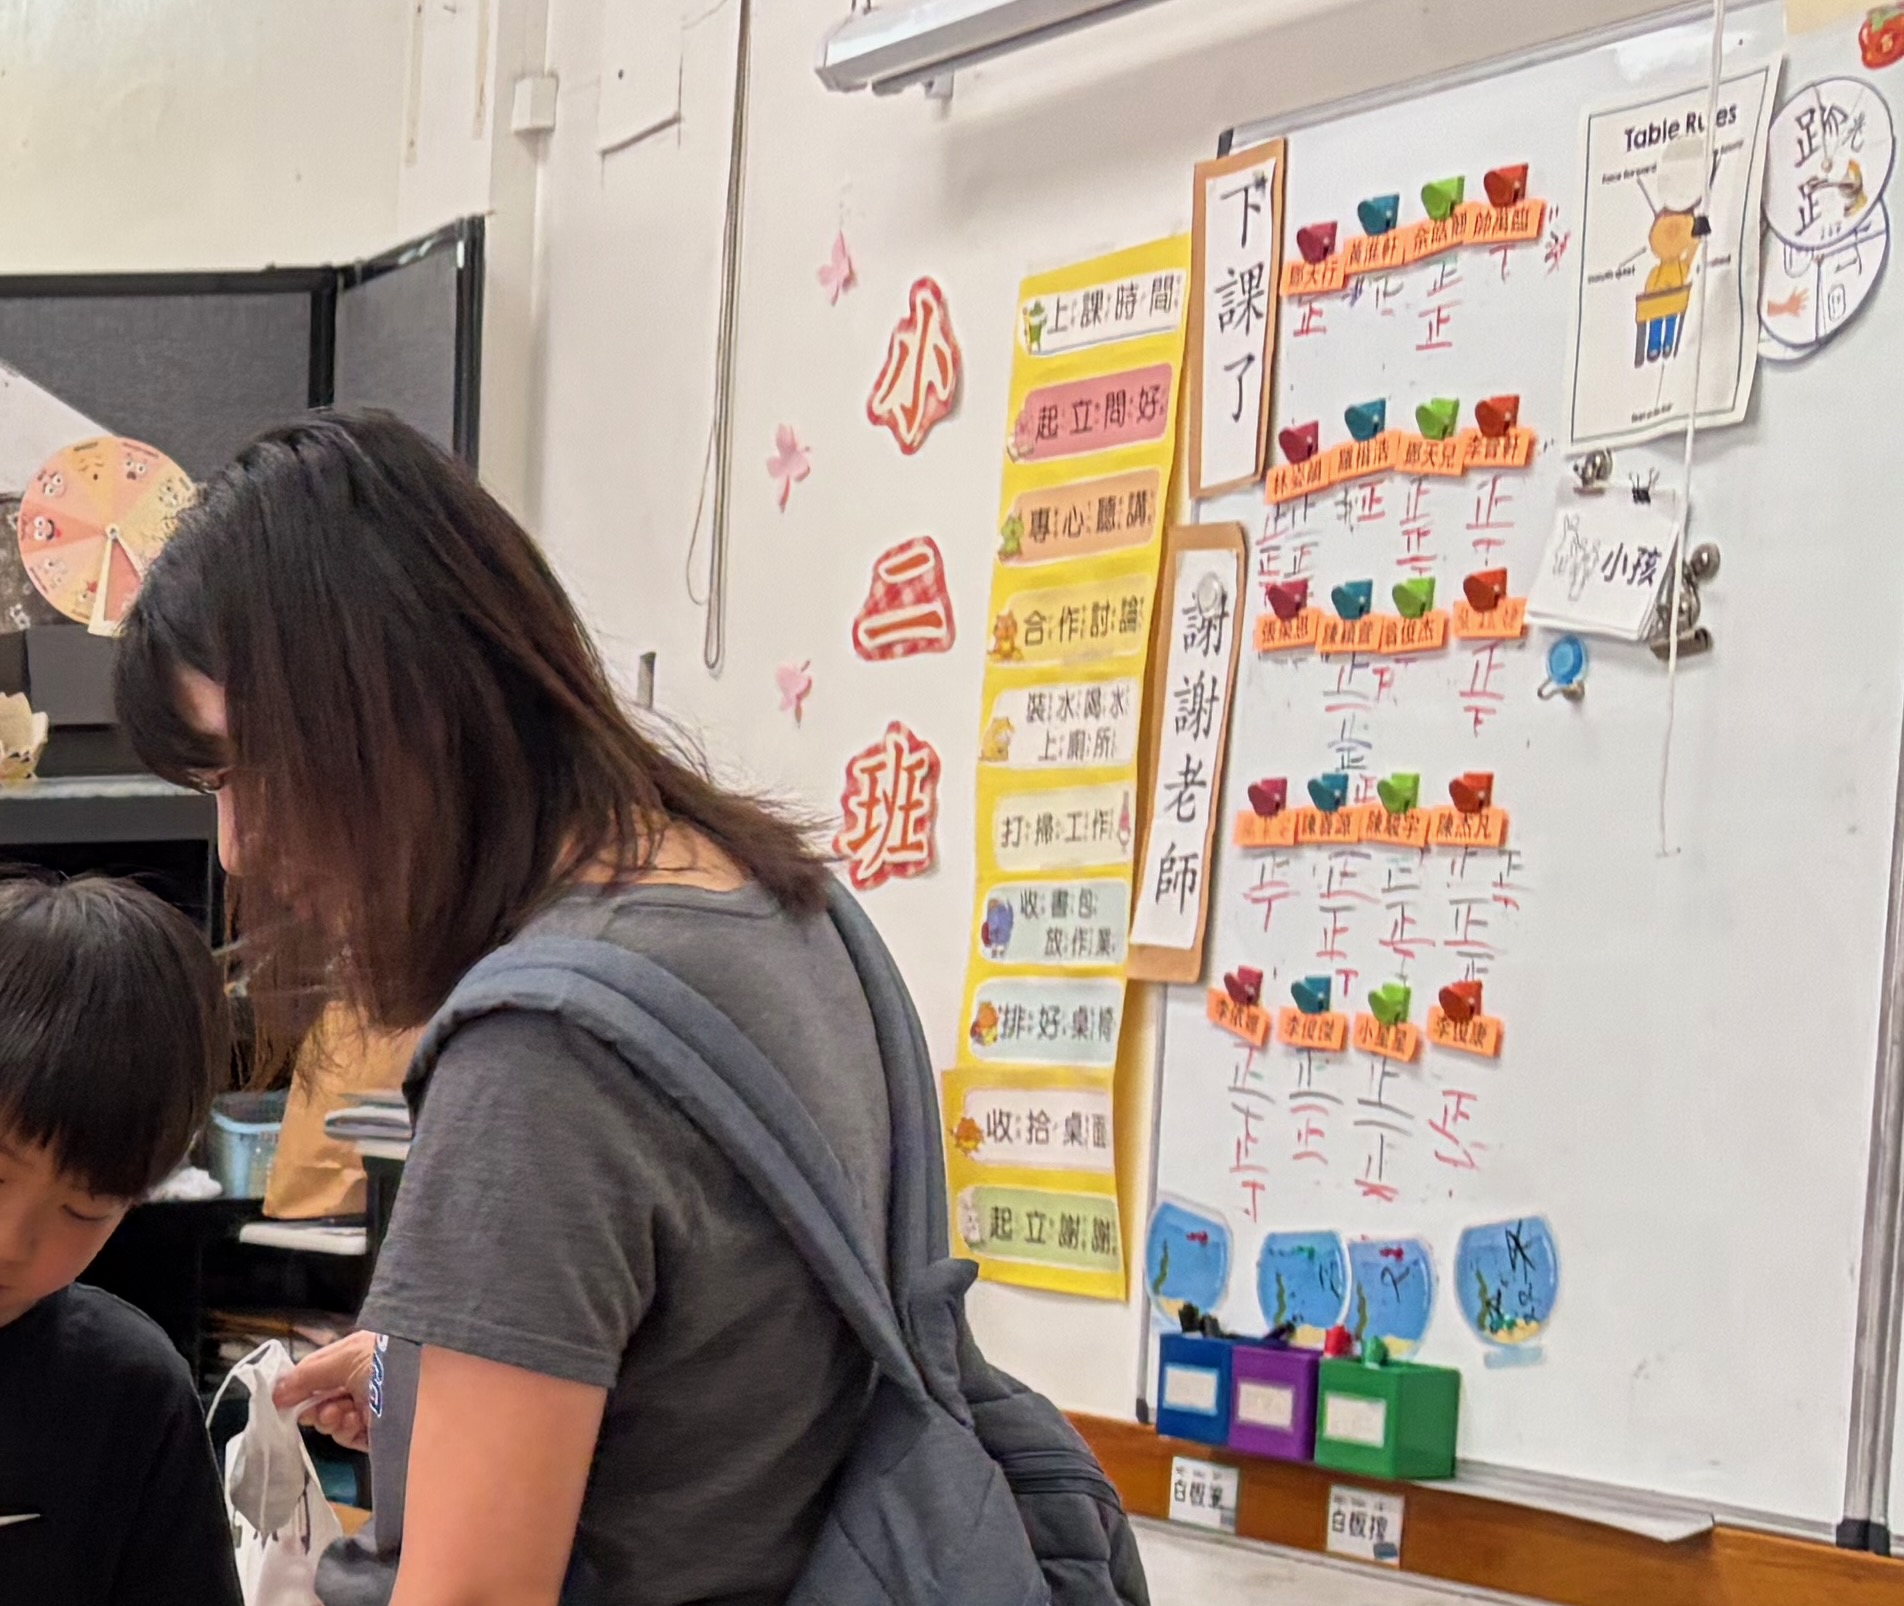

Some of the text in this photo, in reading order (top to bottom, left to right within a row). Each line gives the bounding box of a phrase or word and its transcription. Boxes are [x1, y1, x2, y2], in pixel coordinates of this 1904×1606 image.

[1624, 117, 1681, 153] Table
[1685, 103, 1738, 136] Rues
[1046, 275, 1179, 337] 上課時間
[1214, 182, 1266, 424] 下課了
[873, 290, 955, 446] 小
[1022, 595, 1146, 648] 合作討論
[1154, 592, 1230, 916] 謝謝老師
[844, 732, 939, 882] 班
[1000, 810, 1114, 848] 打掃工作
[1019, 887, 1098, 920] 收書包
[998, 1003, 1116, 1043] 排好桌椅
[986, 1109, 1109, 1150] 收拾桌面
[989, 1206, 1118, 1256] 起立謝謝
